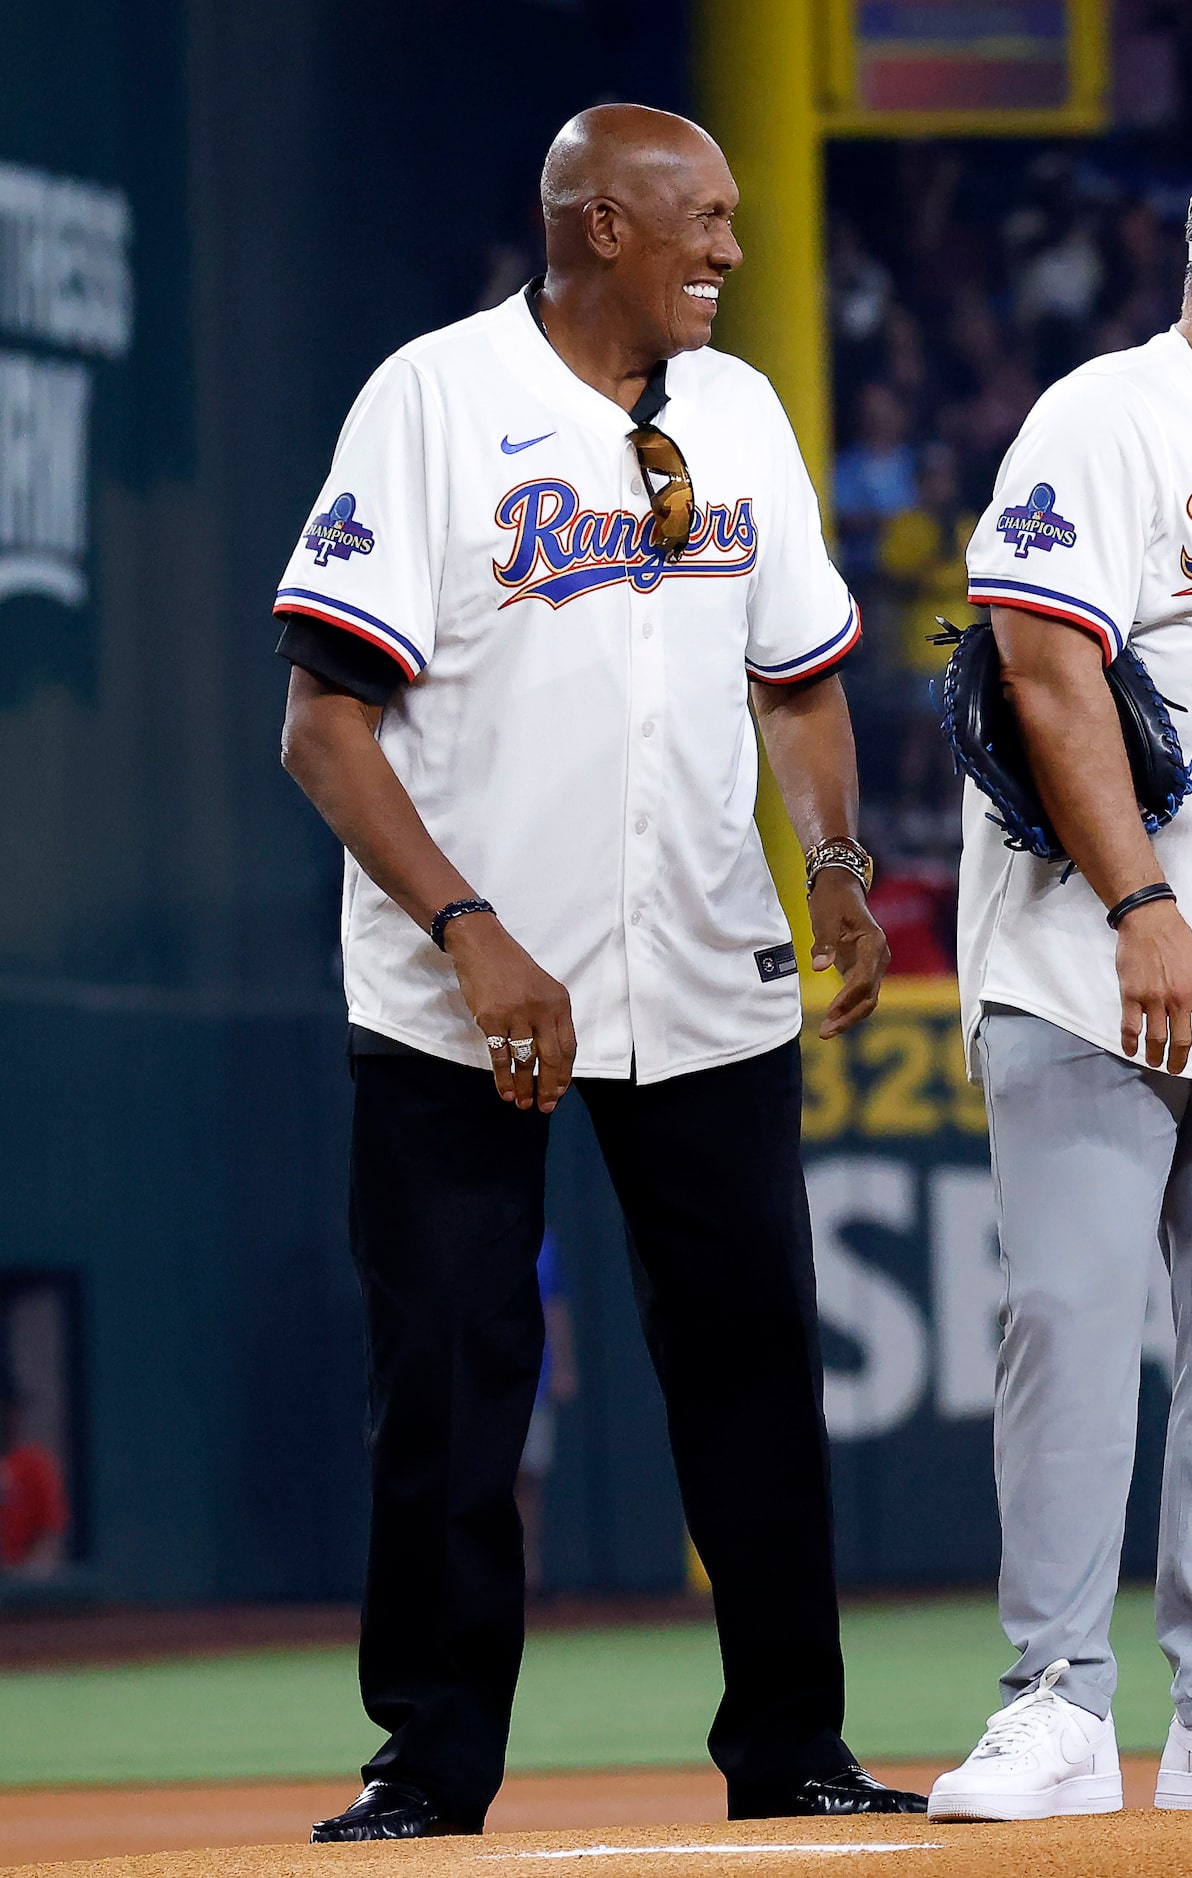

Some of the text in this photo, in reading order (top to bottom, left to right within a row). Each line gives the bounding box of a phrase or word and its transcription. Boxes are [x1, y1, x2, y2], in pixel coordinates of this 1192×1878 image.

[303, 524, 373, 553] HAMPIONS
[997, 515, 1075, 545] CHAMPIONS
[1016, 530, 1036, 553] T
